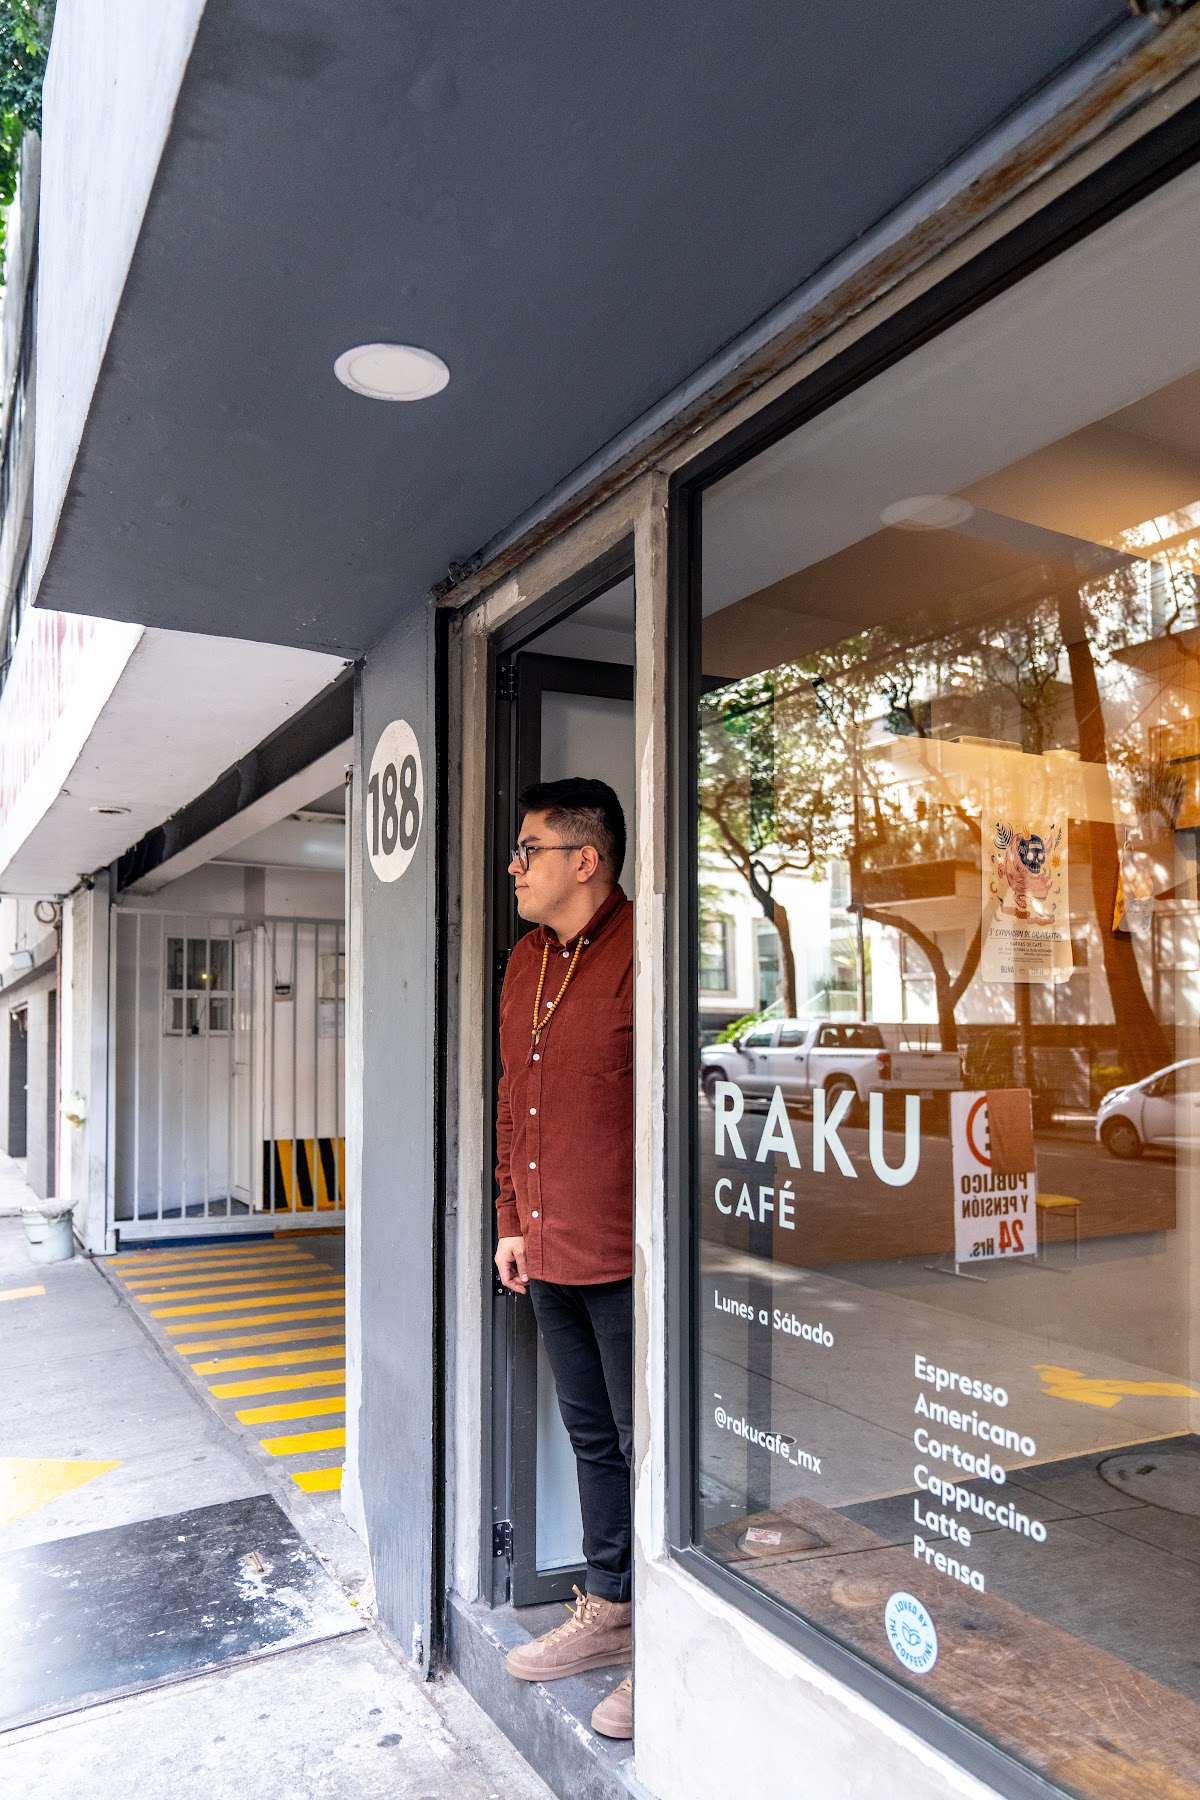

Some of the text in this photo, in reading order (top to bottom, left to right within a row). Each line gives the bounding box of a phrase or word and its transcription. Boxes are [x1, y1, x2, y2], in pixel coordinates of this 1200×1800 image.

[368, 754, 420, 856] 188
[715, 1080, 921, 1187] RAKU
[714, 1177, 795, 1231] CAFÉ
[714, 1290, 834, 1347] Lunes a Sábado
[914, 1354, 1009, 1407] Espresso
[714, 1407, 822, 1475] @rakucafe_mx
[914, 1392, 1036, 1457] Americano
[913, 1428, 1007, 1485] Cortado
[913, 1464, 1047, 1543] Cappuccino
[914, 1498, 972, 1547] Latte
[914, 1534, 985, 1593] Prensa
[895, 1600, 928, 1627] LOVED BY
[889, 1618, 933, 1667] THE COFFEEVINE
